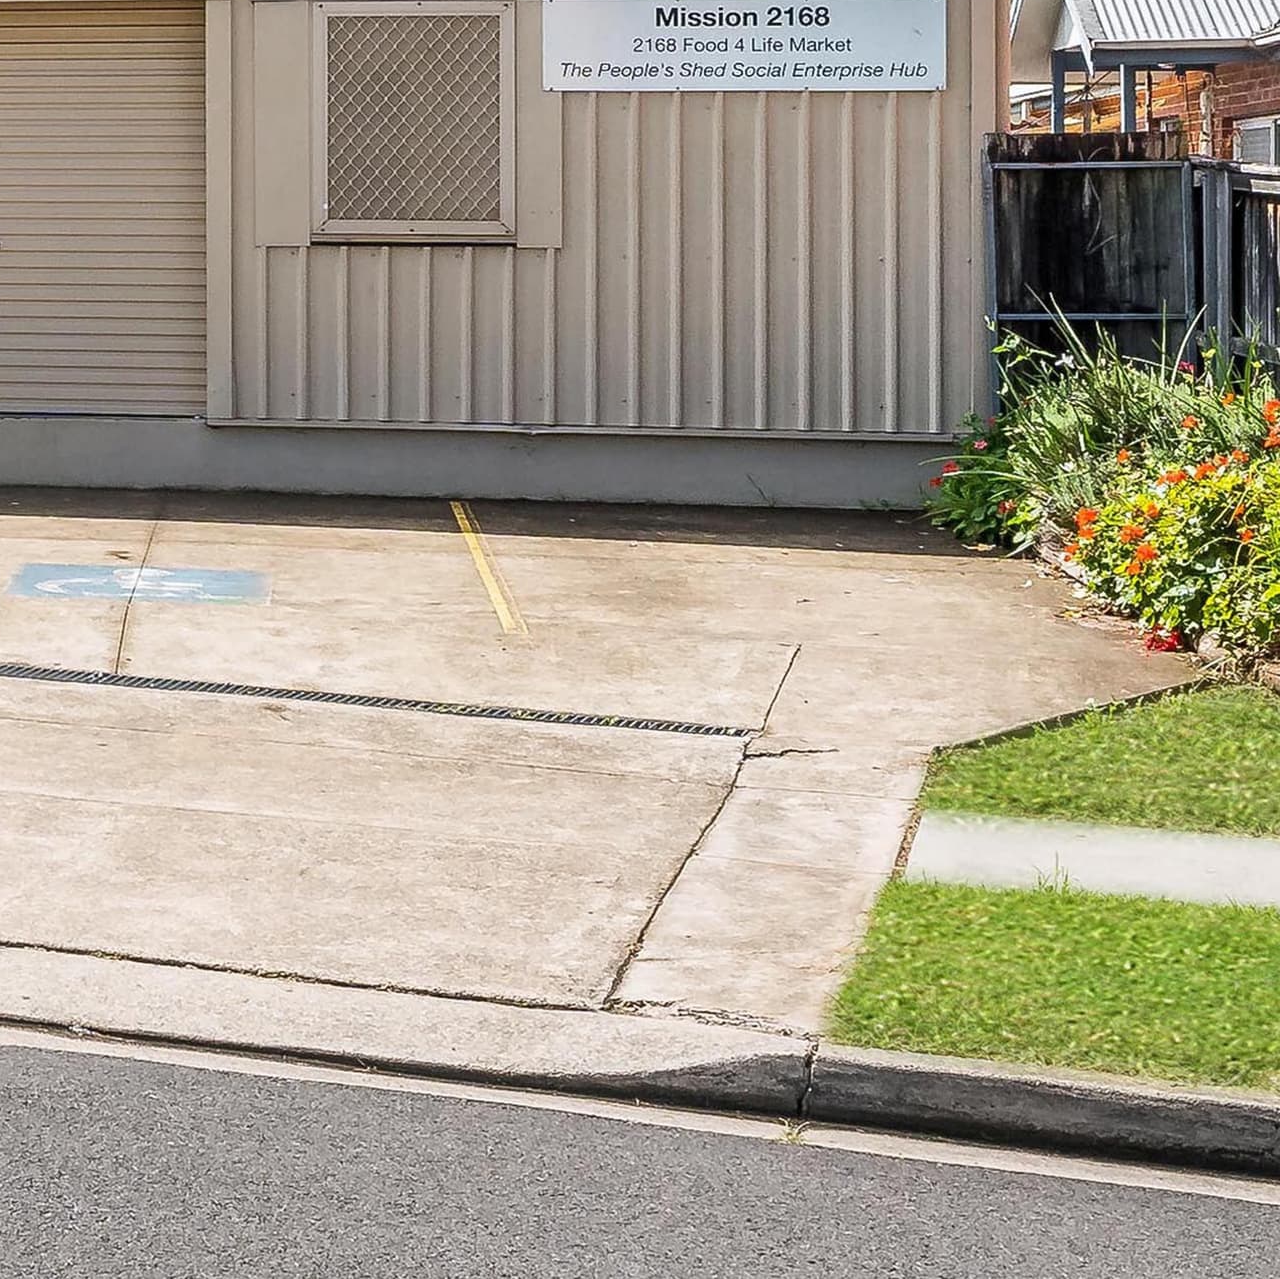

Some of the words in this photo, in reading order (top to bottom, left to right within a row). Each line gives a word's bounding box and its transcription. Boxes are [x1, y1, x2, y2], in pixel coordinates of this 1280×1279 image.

[655, 6, 758, 27] Mission
[766, 6, 831, 27] 2168
[632, 38, 678, 53] 2168
[683, 37, 729, 53] Food
[734, 38, 745, 53] 4
[751, 37, 783, 53] Life
[789, 37, 853, 53] Market
[560, 62, 593, 79] The
[597, 62, 675, 81] People's
[679, 62, 726, 79] Shed
[732, 62, 787, 79] Social
[792, 62, 884, 81] Enterprise
[890, 62, 929, 78] Hub
